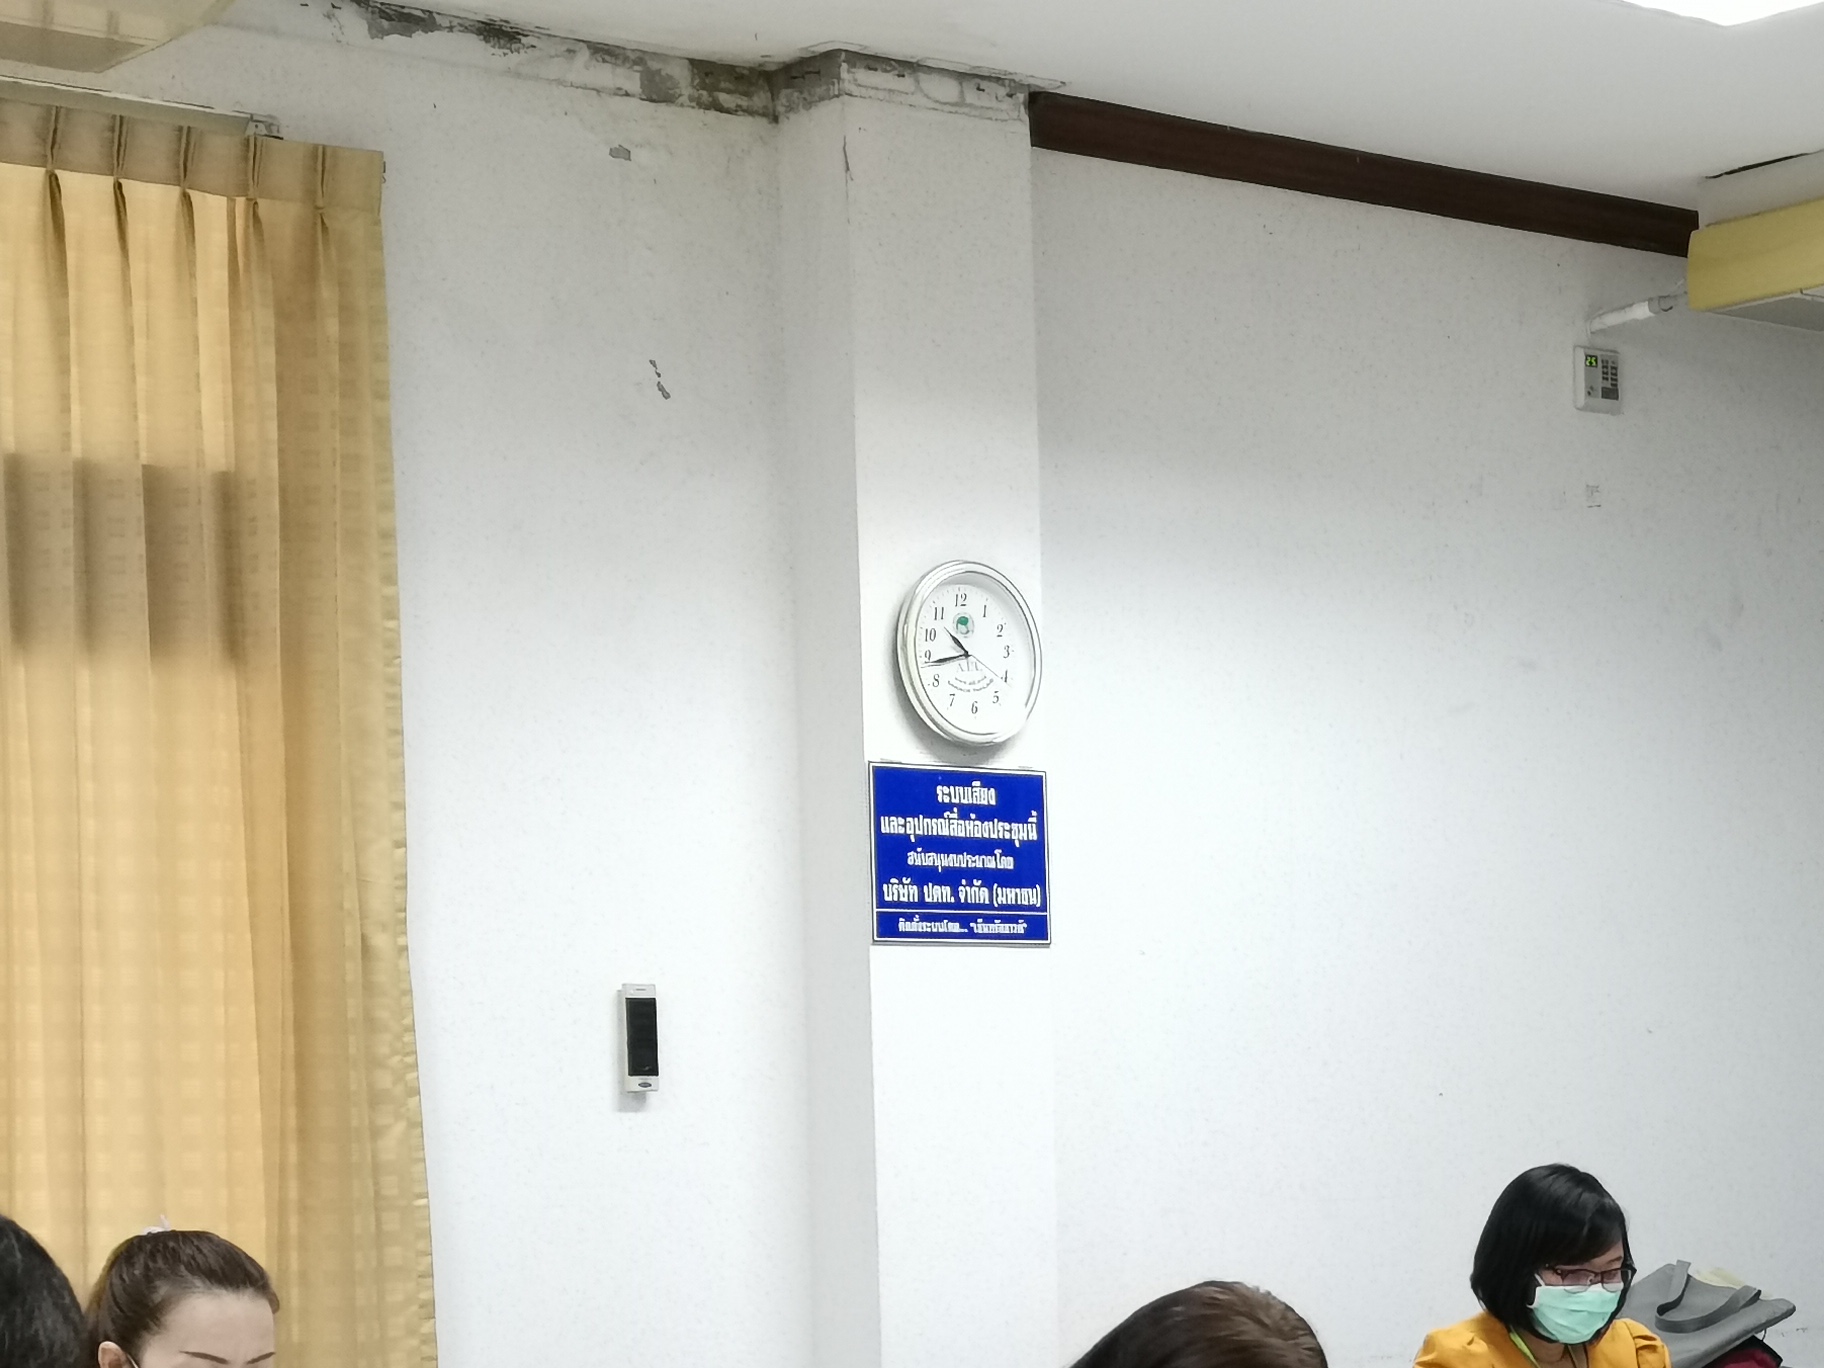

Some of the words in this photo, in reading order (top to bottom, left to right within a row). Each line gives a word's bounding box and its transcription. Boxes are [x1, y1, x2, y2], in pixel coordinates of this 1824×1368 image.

[954, 593, 967, 607] 12
[934, 606, 944, 620] 11
[924, 628, 936, 642] 10
[996, 623, 1004, 638] 2
[1003, 645, 1010, 659] 3
[932, 674, 940, 688] 8
[950, 694, 956, 707] 7
[992, 690, 1000, 704] 5
[971, 700, 978, 714] 6
[936, 780, 997, 806] ระบบเสียง
[882, 877, 919, 903] บริษัท
[958, 879, 990, 905] จำกัด
